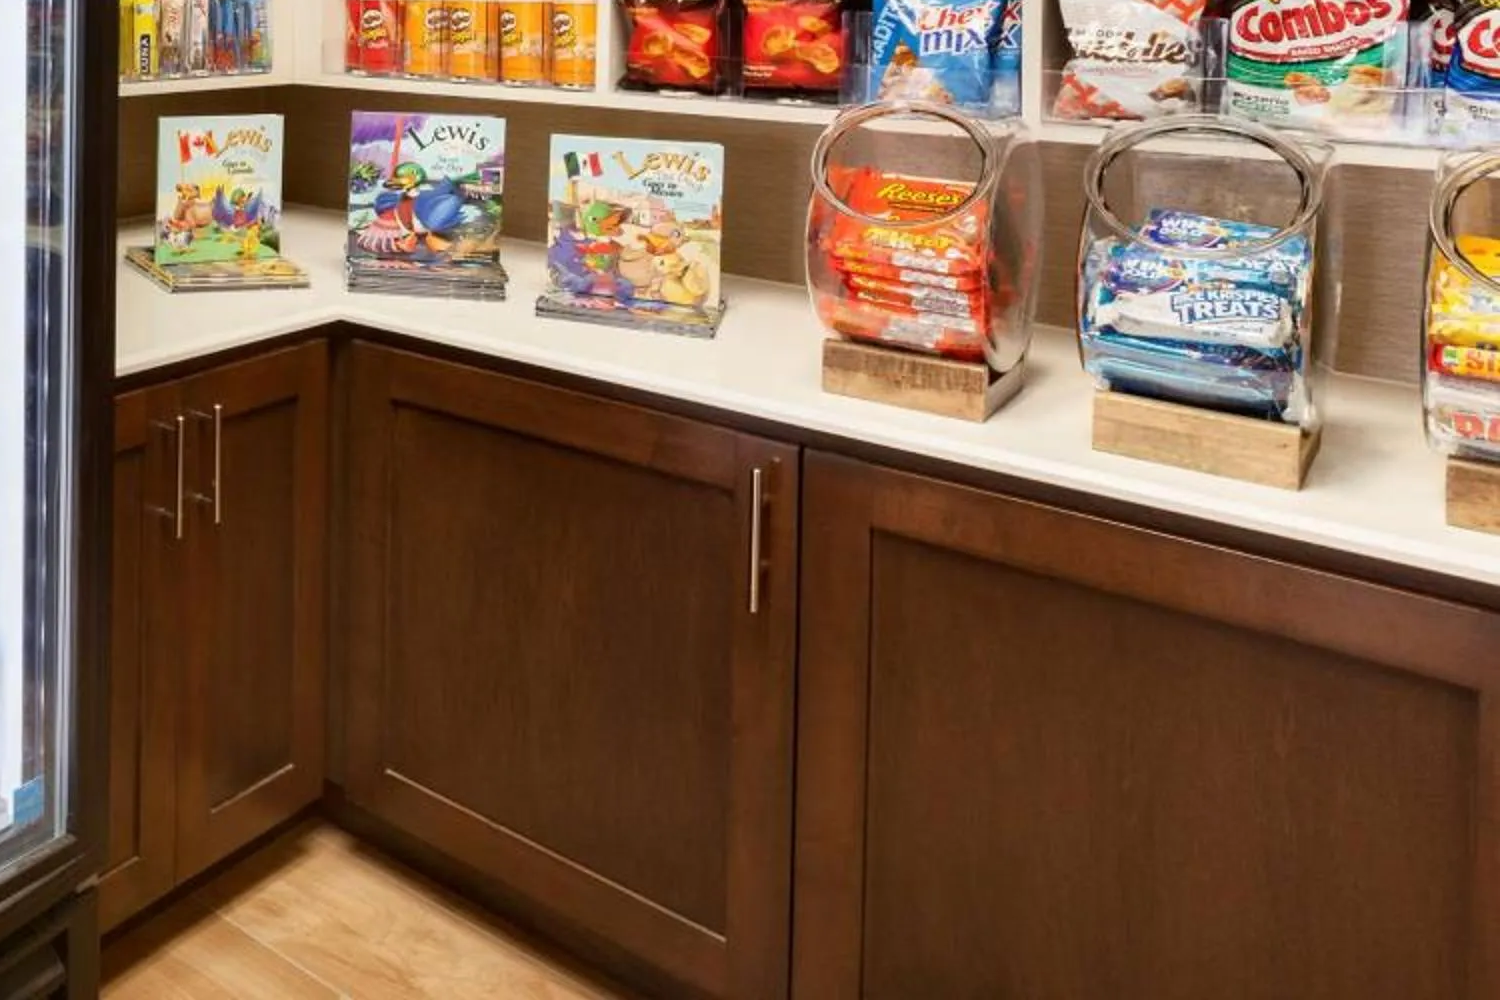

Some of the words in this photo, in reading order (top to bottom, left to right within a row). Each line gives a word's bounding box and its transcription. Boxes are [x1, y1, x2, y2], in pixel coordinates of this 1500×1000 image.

[920, 27, 987, 57] mix
[407, 122, 491, 152] Lewis
[612, 150, 710, 181] Lewis
[1177, 300, 1279, 325] TREATS
